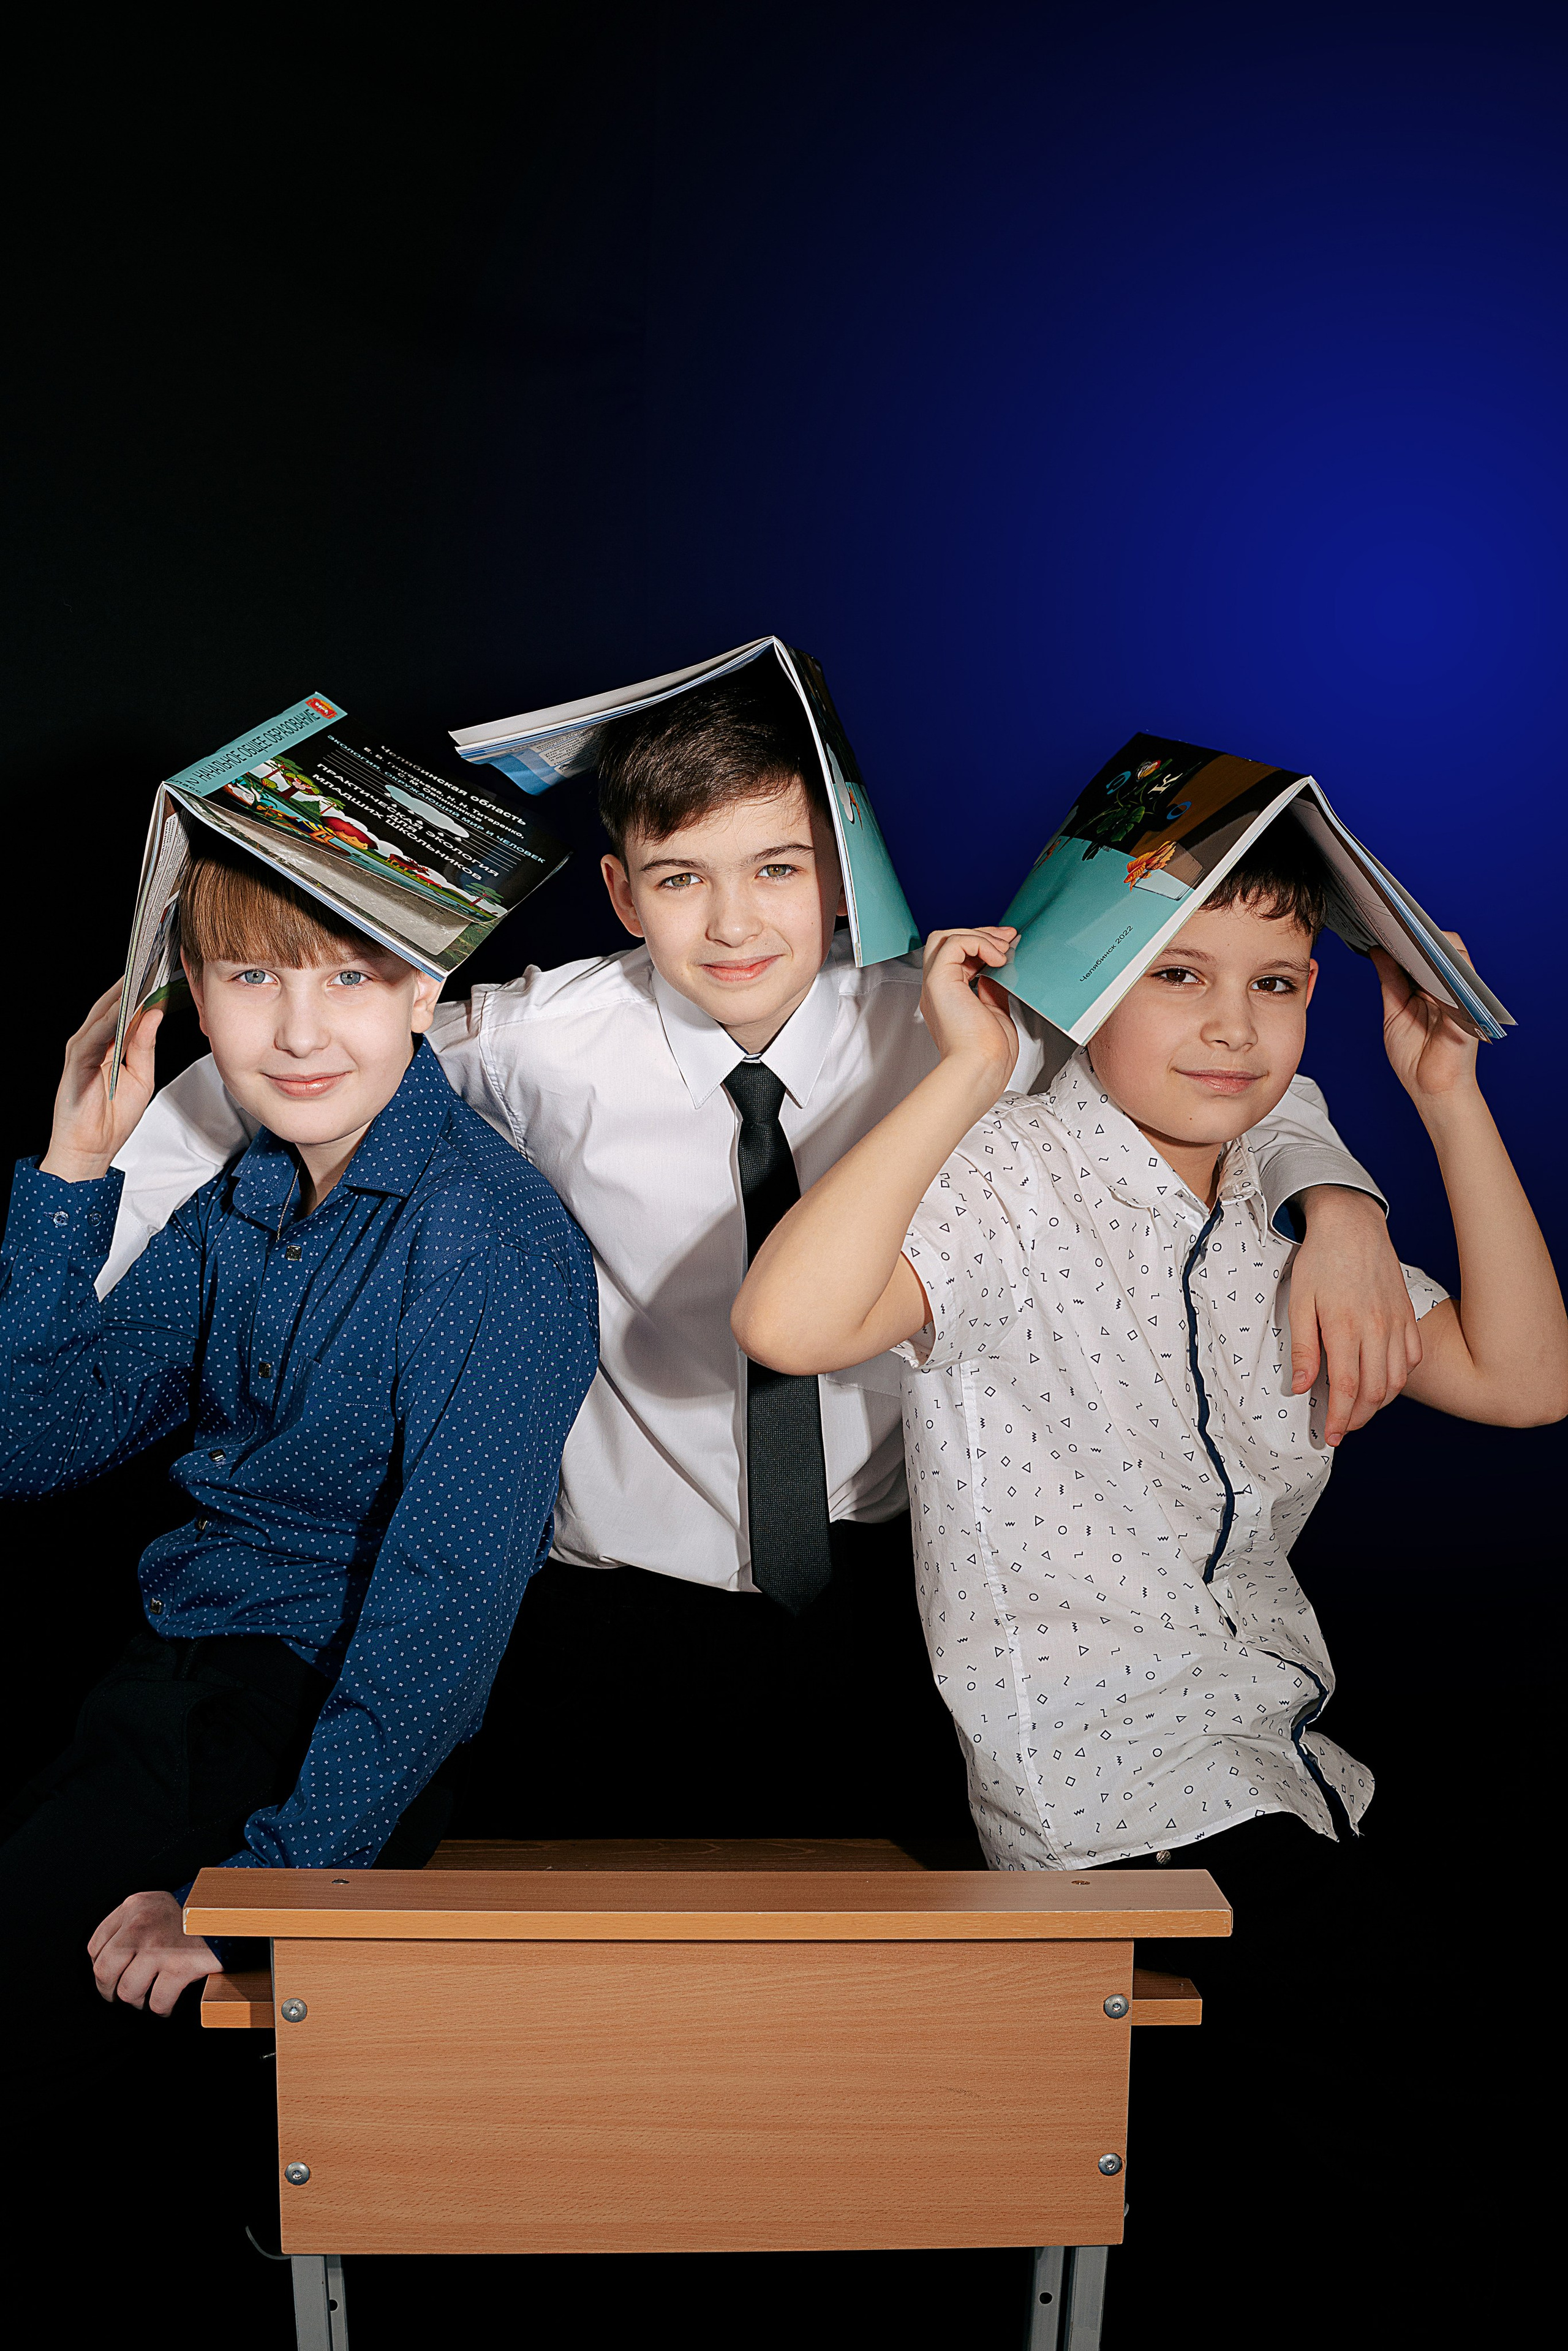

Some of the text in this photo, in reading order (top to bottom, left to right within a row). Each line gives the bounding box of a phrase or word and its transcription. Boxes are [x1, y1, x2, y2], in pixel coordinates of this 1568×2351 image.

[192, 709, 321, 782] НАЧАЛЬНОЕ ОБЩЕЕ ОБРАЗОВАНИЕ
[168, 779, 202, 794] класс
[381, 745, 526, 825] Челябинская область
[423, 787, 482, 822] Овчинников
[312, 774, 482, 880] МЛАДШИХ ШКОЛЬНИКОВ
[317, 763, 499, 877] ПРАКТИЧЕСКАЯ ЭКОЛОГИЯ
[385, 772, 460, 817] ОКРУЖАЮЩИЙ
[461, 817, 484, 831] МИР
[496, 836, 546, 864] ЧЕЛОВЕК
[386, 814, 417, 832] ДЛЯ
[473, 809, 524, 839] Титаренко,
[1079, 926, 1133, 982] Челябинск 2022
